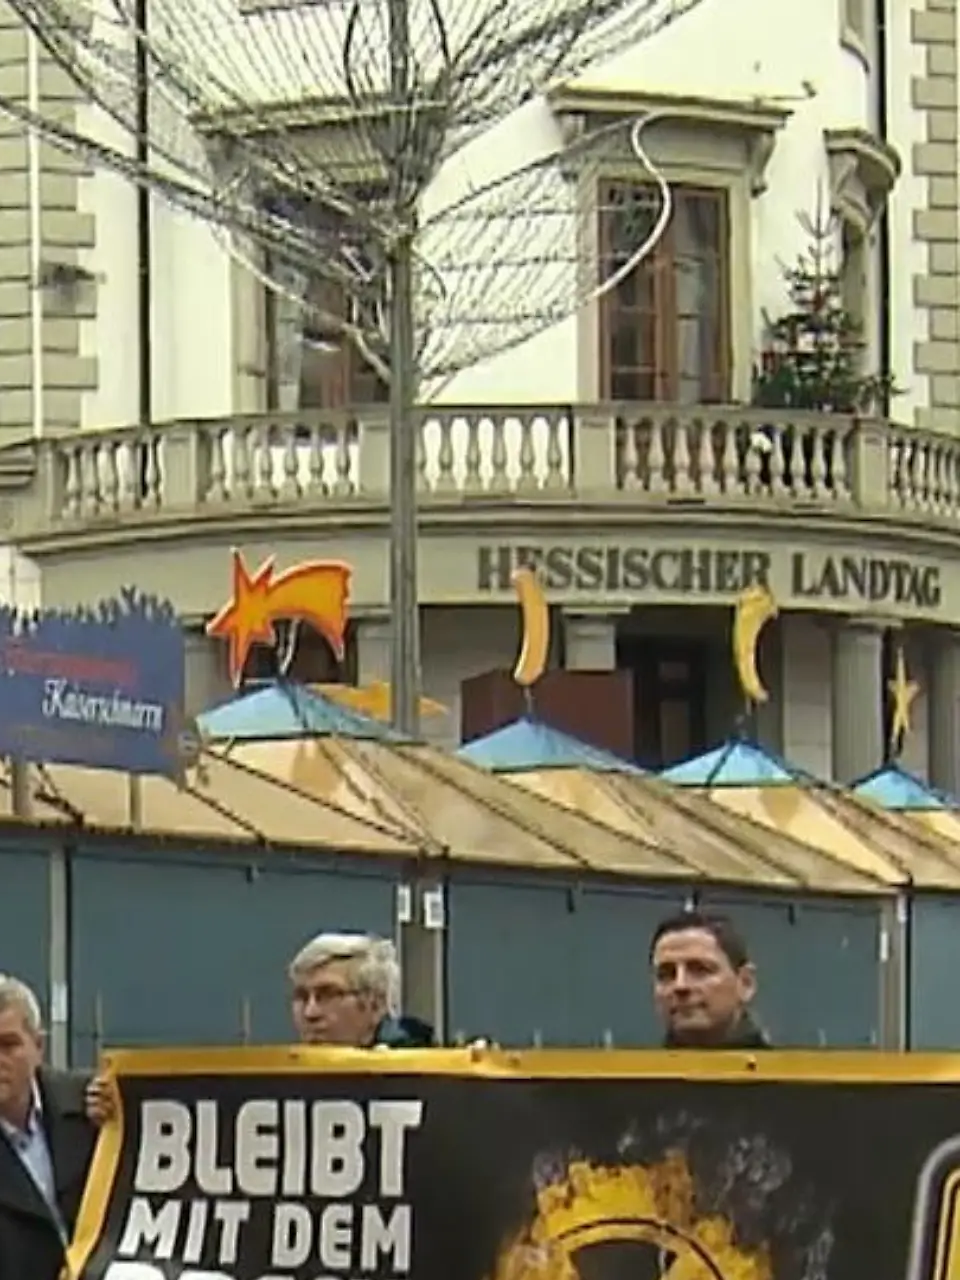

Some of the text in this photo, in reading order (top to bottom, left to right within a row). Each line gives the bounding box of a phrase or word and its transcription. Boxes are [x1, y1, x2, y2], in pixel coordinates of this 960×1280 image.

[478, 546, 941, 607] HESSISCHER LANDTAG
[134, 1099, 423, 1198] BLEIBT
[118, 1197, 411, 1272] MIT DEM
